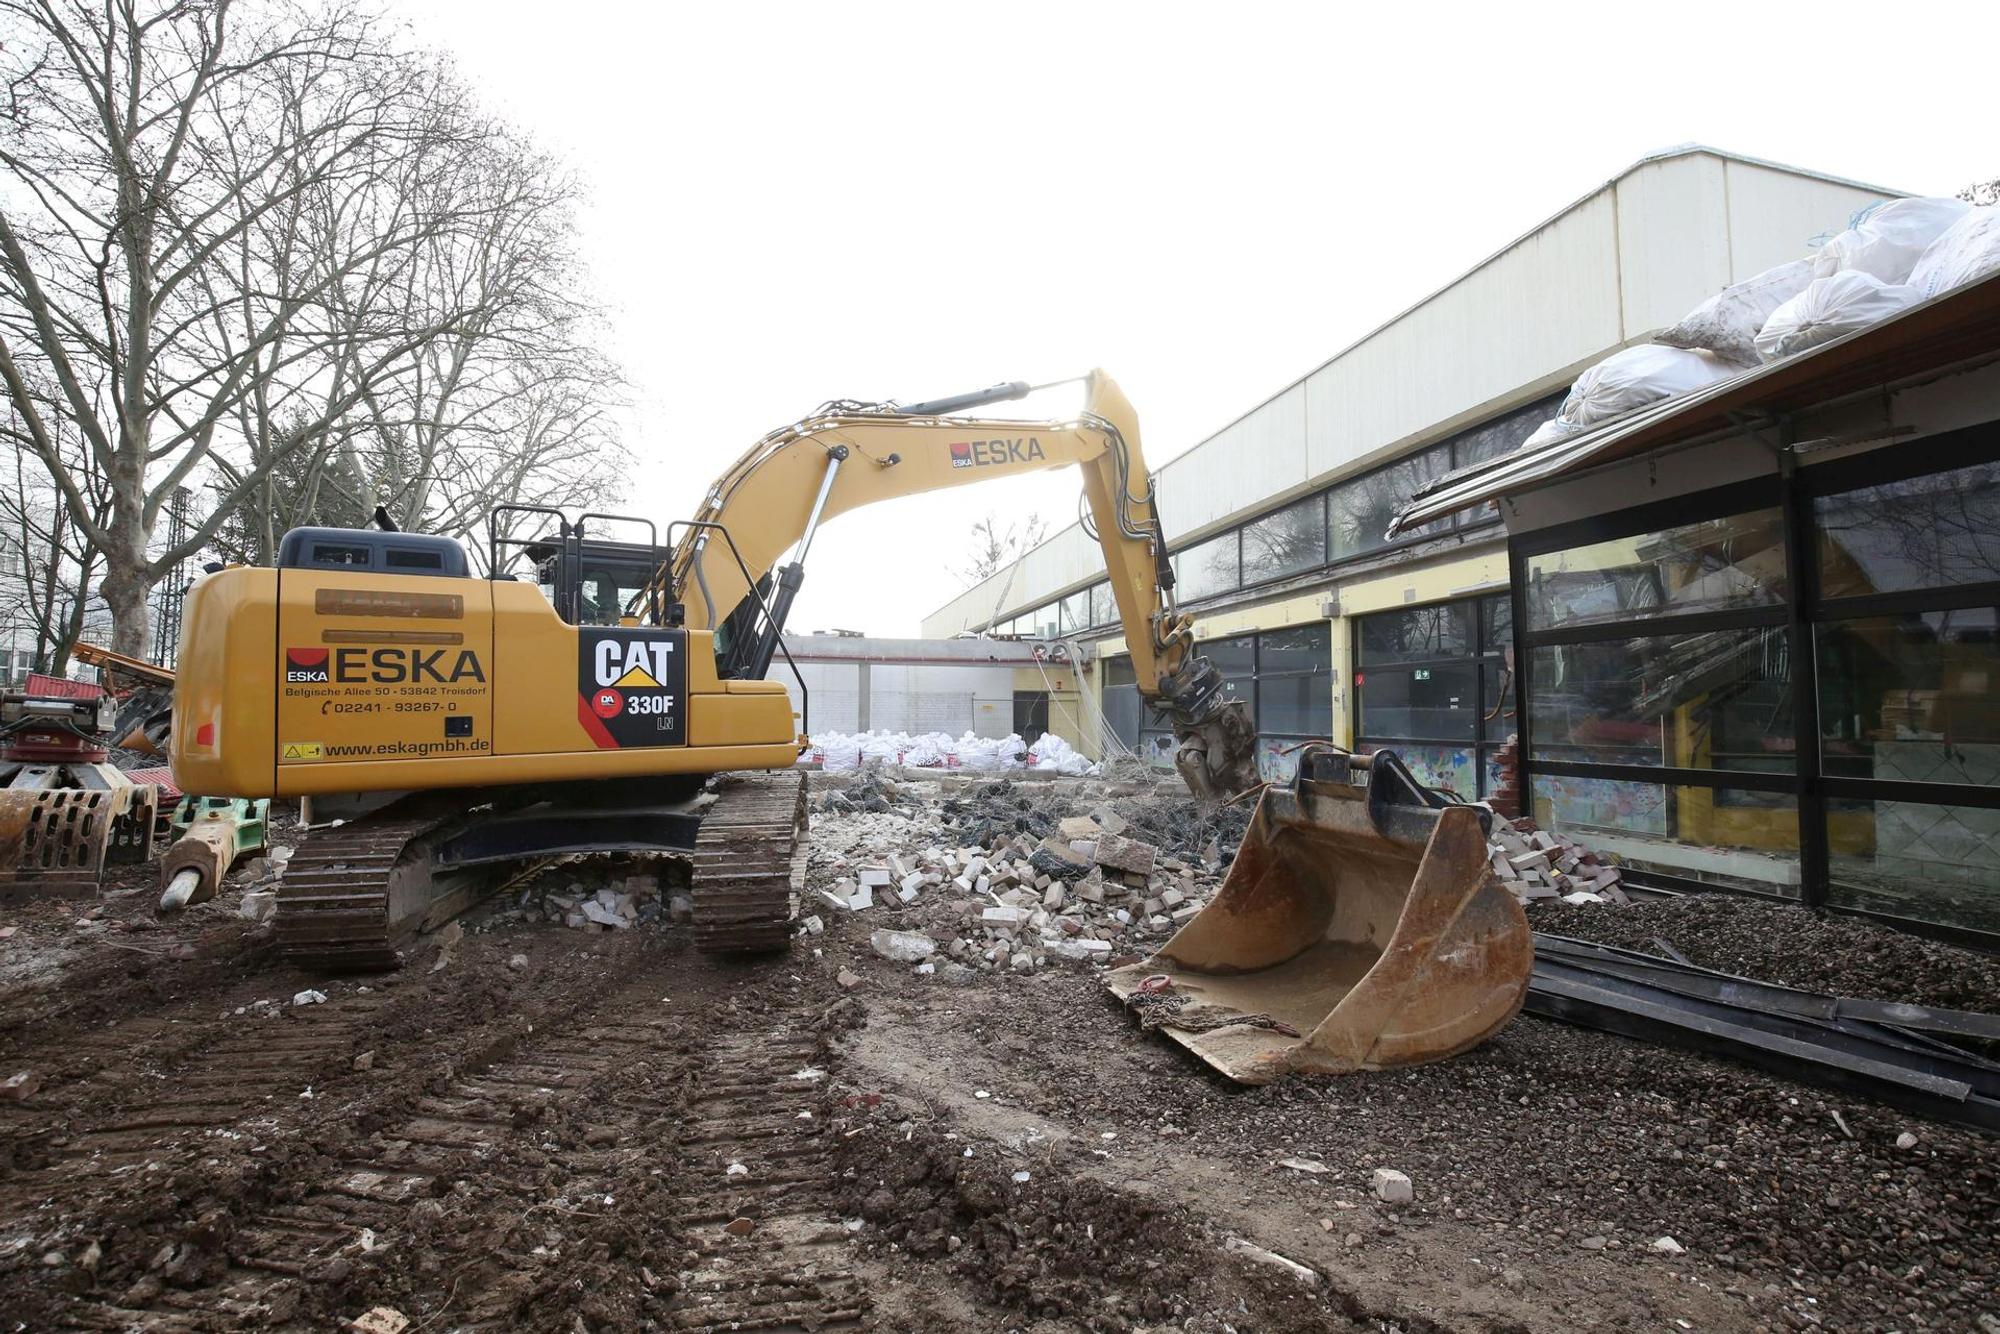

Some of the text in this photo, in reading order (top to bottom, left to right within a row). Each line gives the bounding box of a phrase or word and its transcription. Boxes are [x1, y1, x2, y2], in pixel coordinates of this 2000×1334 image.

[972, 437, 1046, 466] ESKA
[953, 459, 972, 468] ESKA
[336, 648, 486, 683] ESKA
[595, 639, 674, 687] CAT
[287, 672, 328, 682] ESKA
[285, 687, 341, 698] Belgische
[344, 687, 371, 696] Allee
[375, 687, 390, 696] 50
[400, 687, 438, 696] 53842
[441, 686, 487, 696] Troisdorf
[334, 703, 382, 714] 02241
[628, 695, 674, 715] 330F
[657, 717, 674, 731] LN
[325, 739, 489, 756] www.eskagmbh.de
